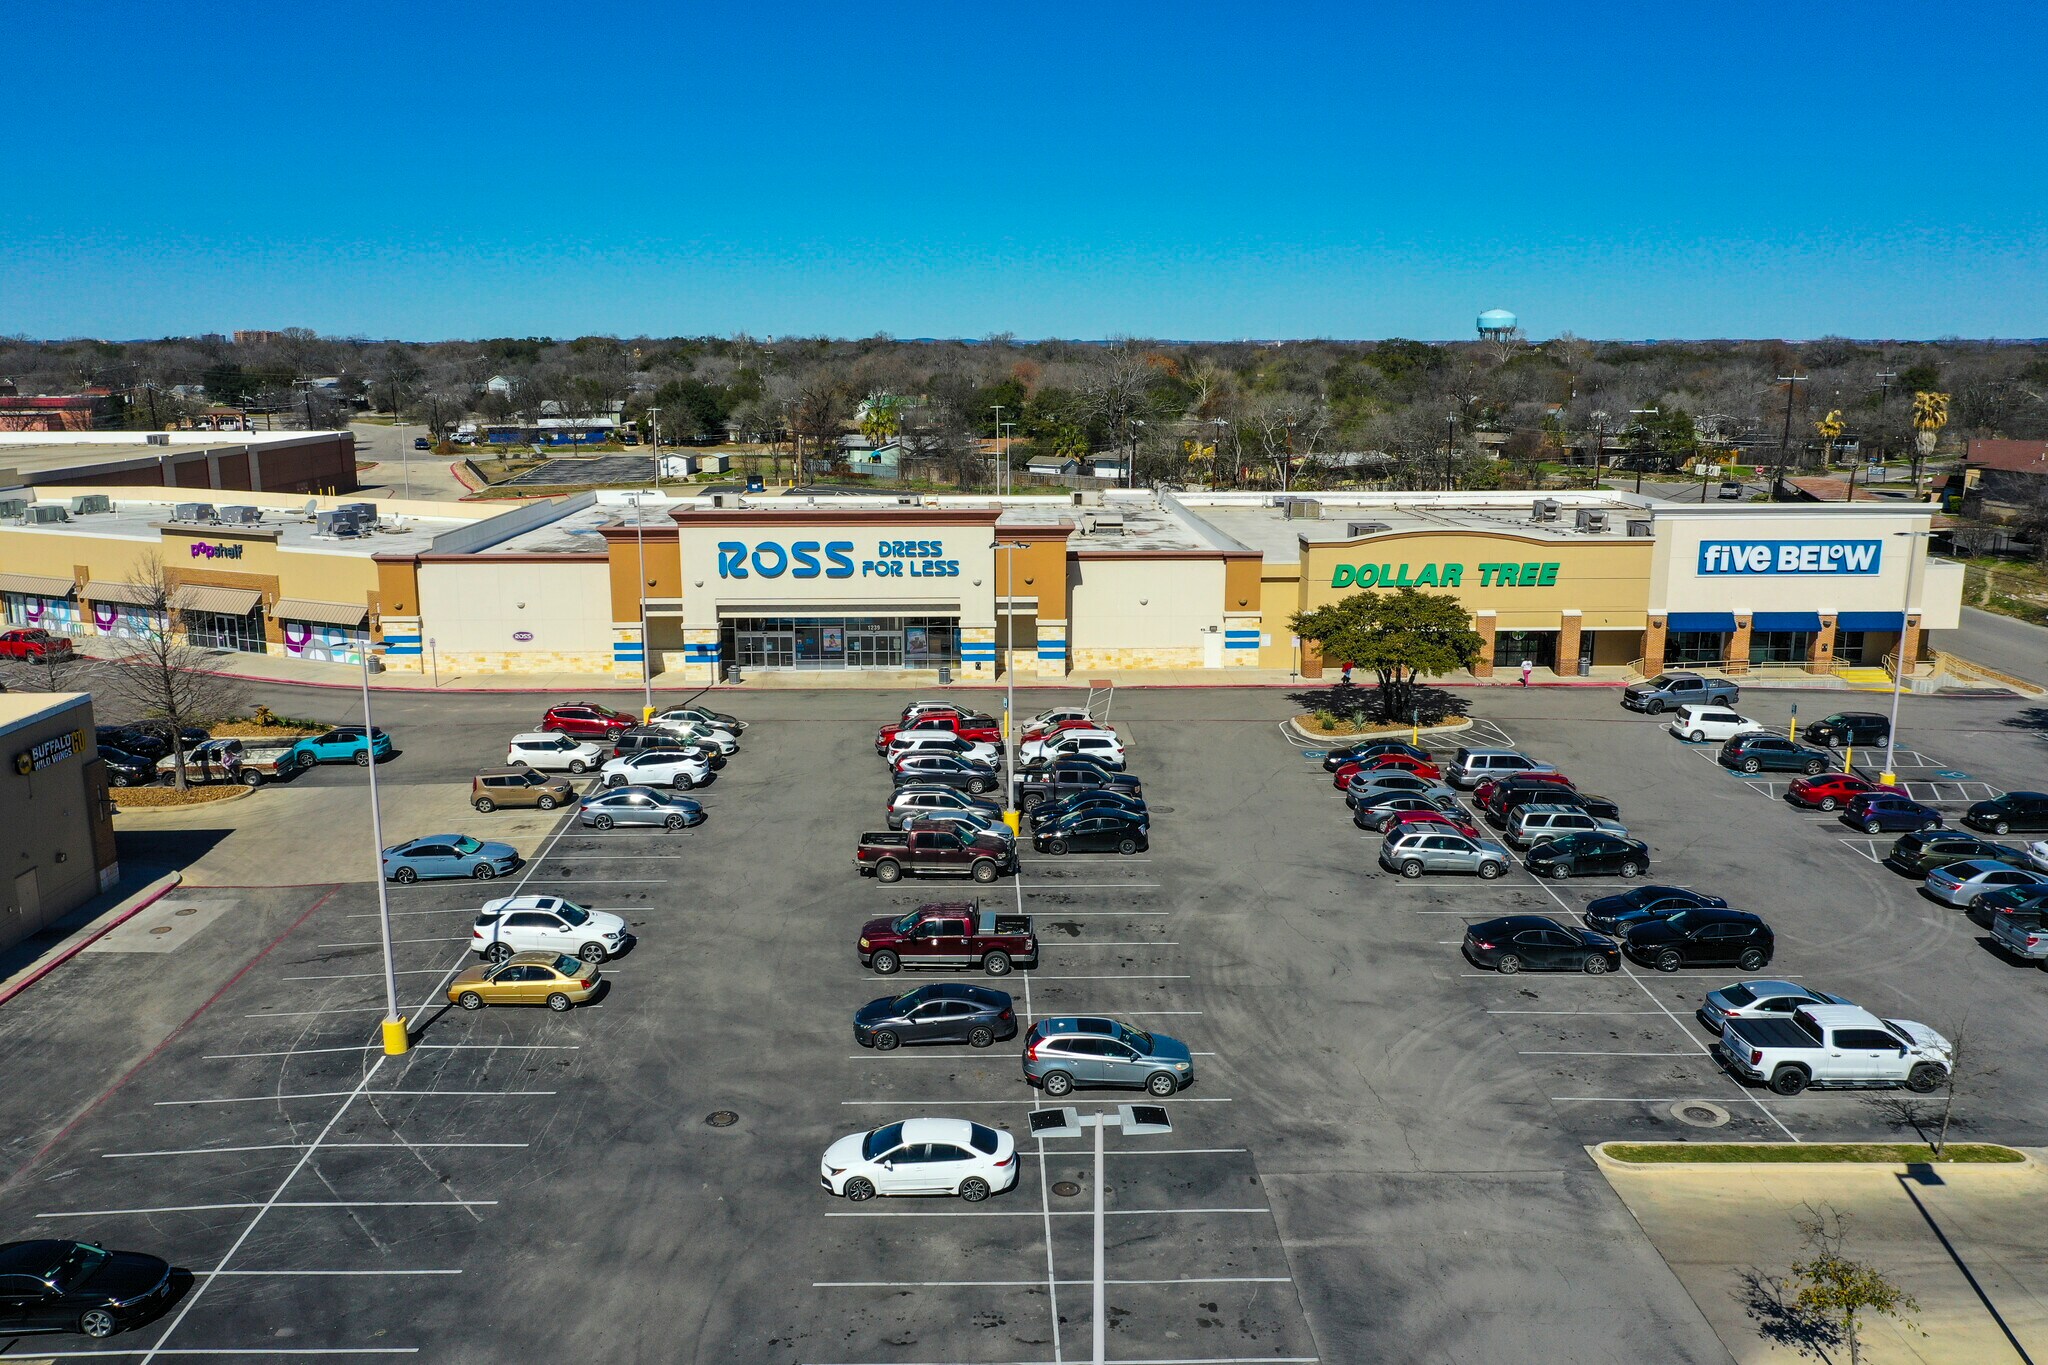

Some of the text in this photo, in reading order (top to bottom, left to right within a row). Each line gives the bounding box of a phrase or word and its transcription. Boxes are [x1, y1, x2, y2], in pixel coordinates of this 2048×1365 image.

[191, 542, 243, 560] popshelf
[718, 541, 855, 579] ROSS
[878, 541, 943, 558] DRESS
[862, 560, 960, 577] FOR LESS
[1331, 563, 1561, 588] DOLLAR TREE
[32, 734, 72, 761] BUFFALO
[71, 728, 87, 754] GO
[33, 747, 73, 771] WILD WINGS
